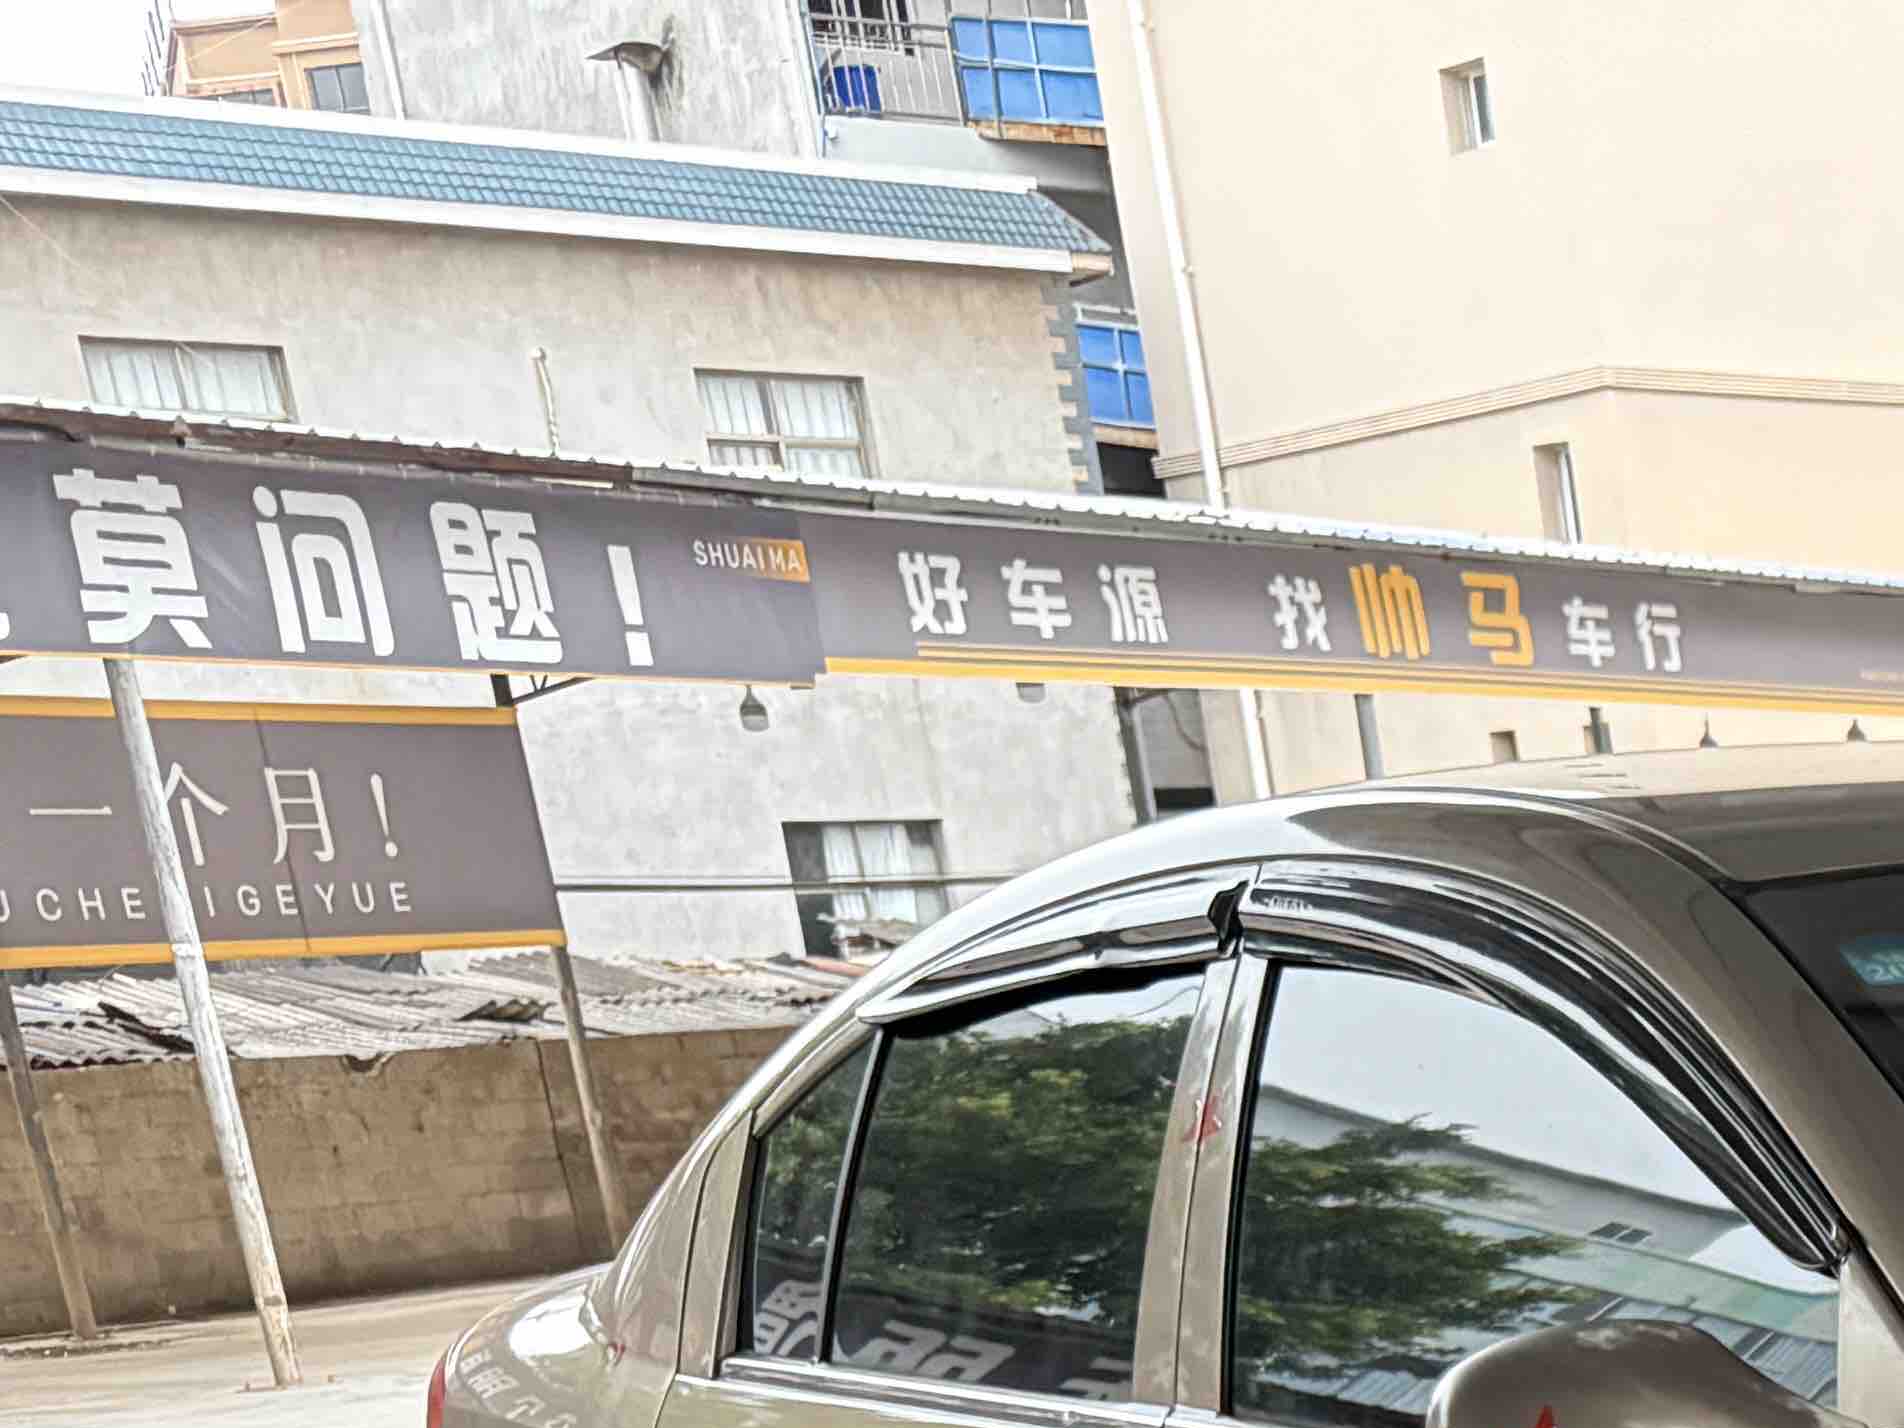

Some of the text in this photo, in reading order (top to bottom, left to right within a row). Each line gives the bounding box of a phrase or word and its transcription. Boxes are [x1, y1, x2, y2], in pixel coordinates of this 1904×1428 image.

[898, 552, 1682, 673] 好车源 找帅马车行
